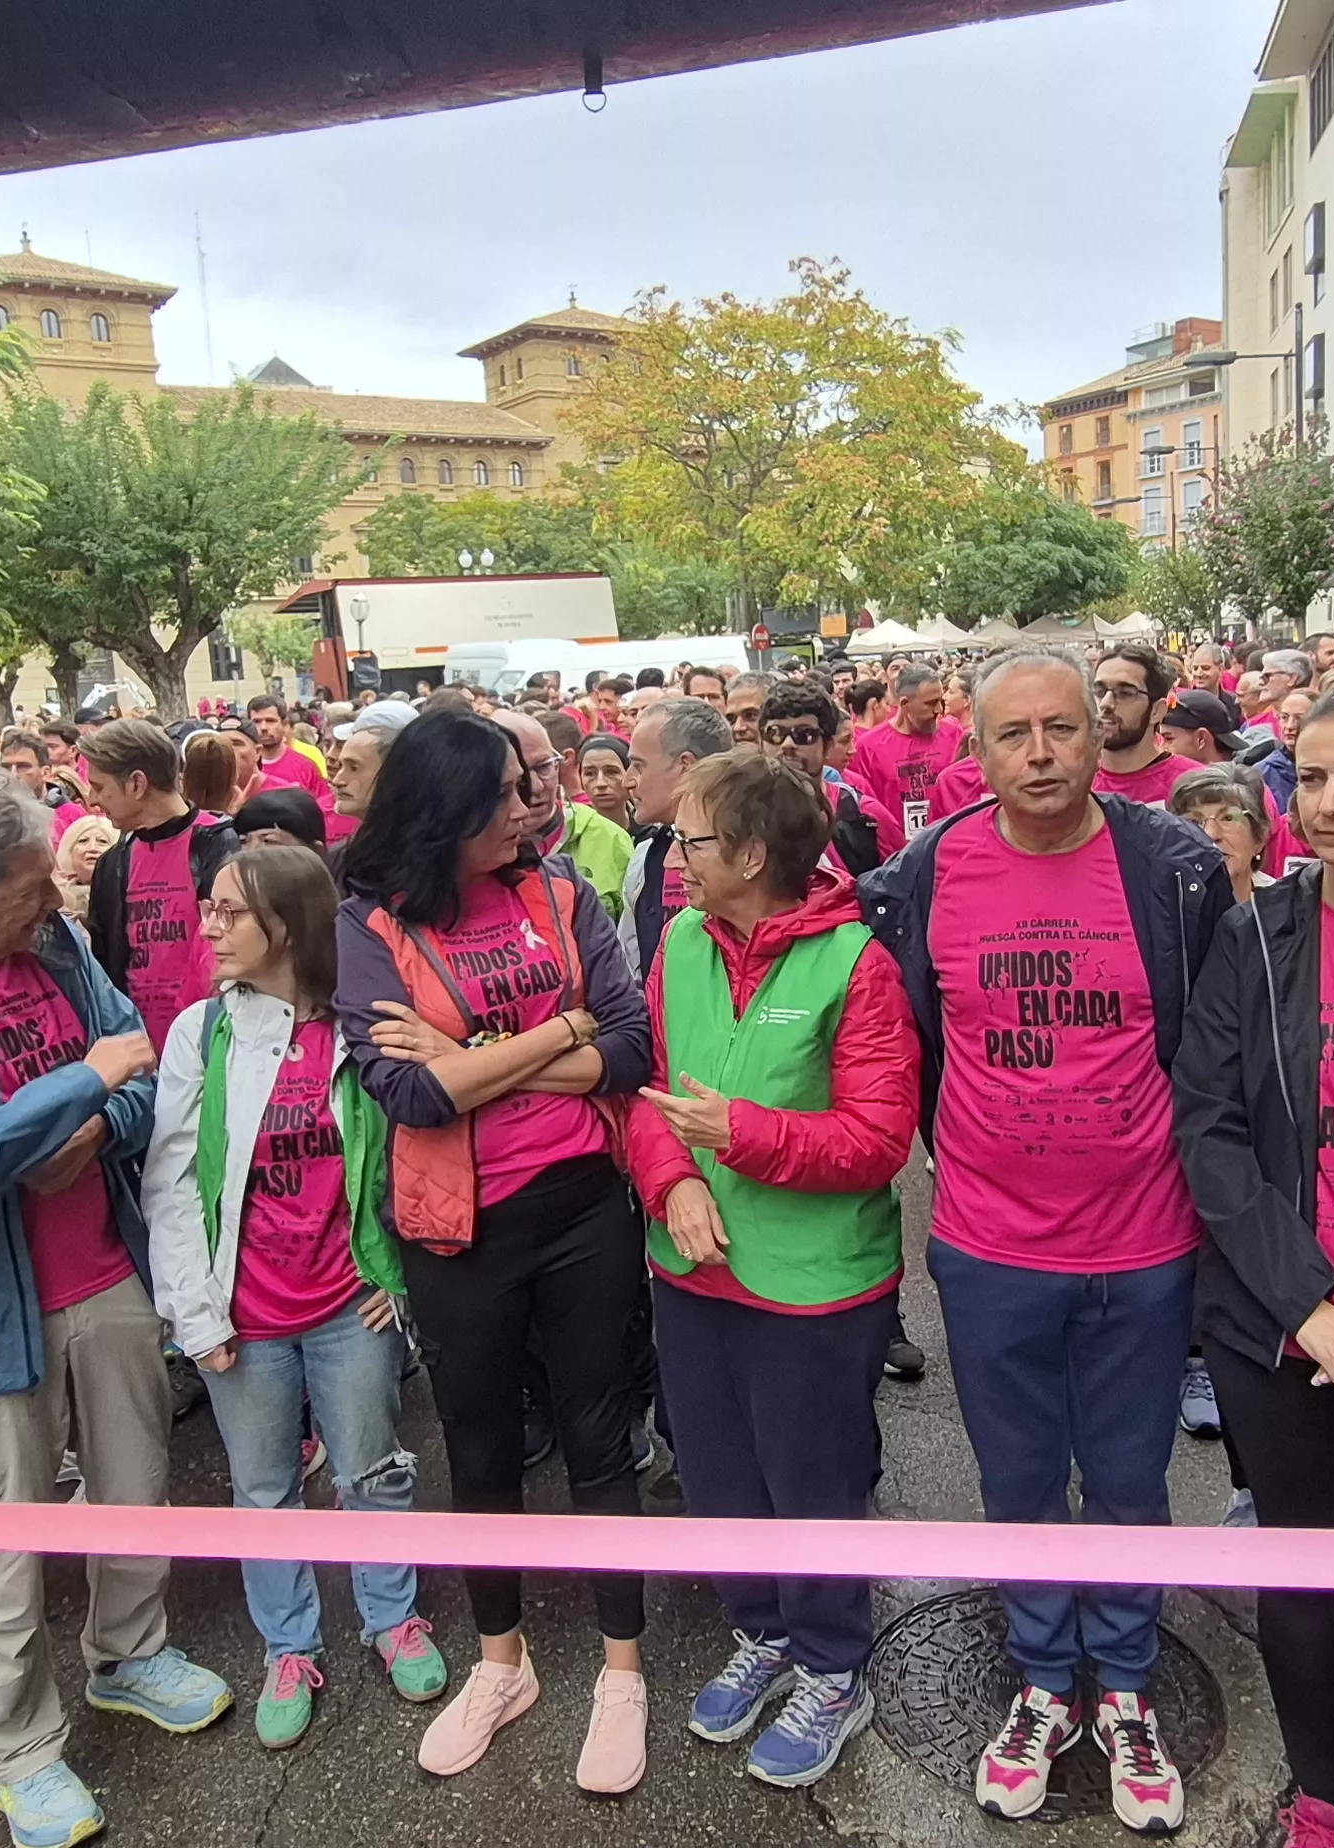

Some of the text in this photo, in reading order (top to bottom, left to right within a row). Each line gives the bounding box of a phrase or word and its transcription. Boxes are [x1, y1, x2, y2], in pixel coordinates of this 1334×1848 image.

[979, 929, 1120, 944] HUESCA CONTRA EL CÁNCER
[1030, 919, 1079, 928] CARRERA
[979, 950, 1073, 990] UNIDOS
[480, 972, 517, 1008] EN
[1017, 990, 1123, 1028] EN CADA
[984, 1028, 1054, 1069] PASO
[270, 1133, 300, 1162] EN
